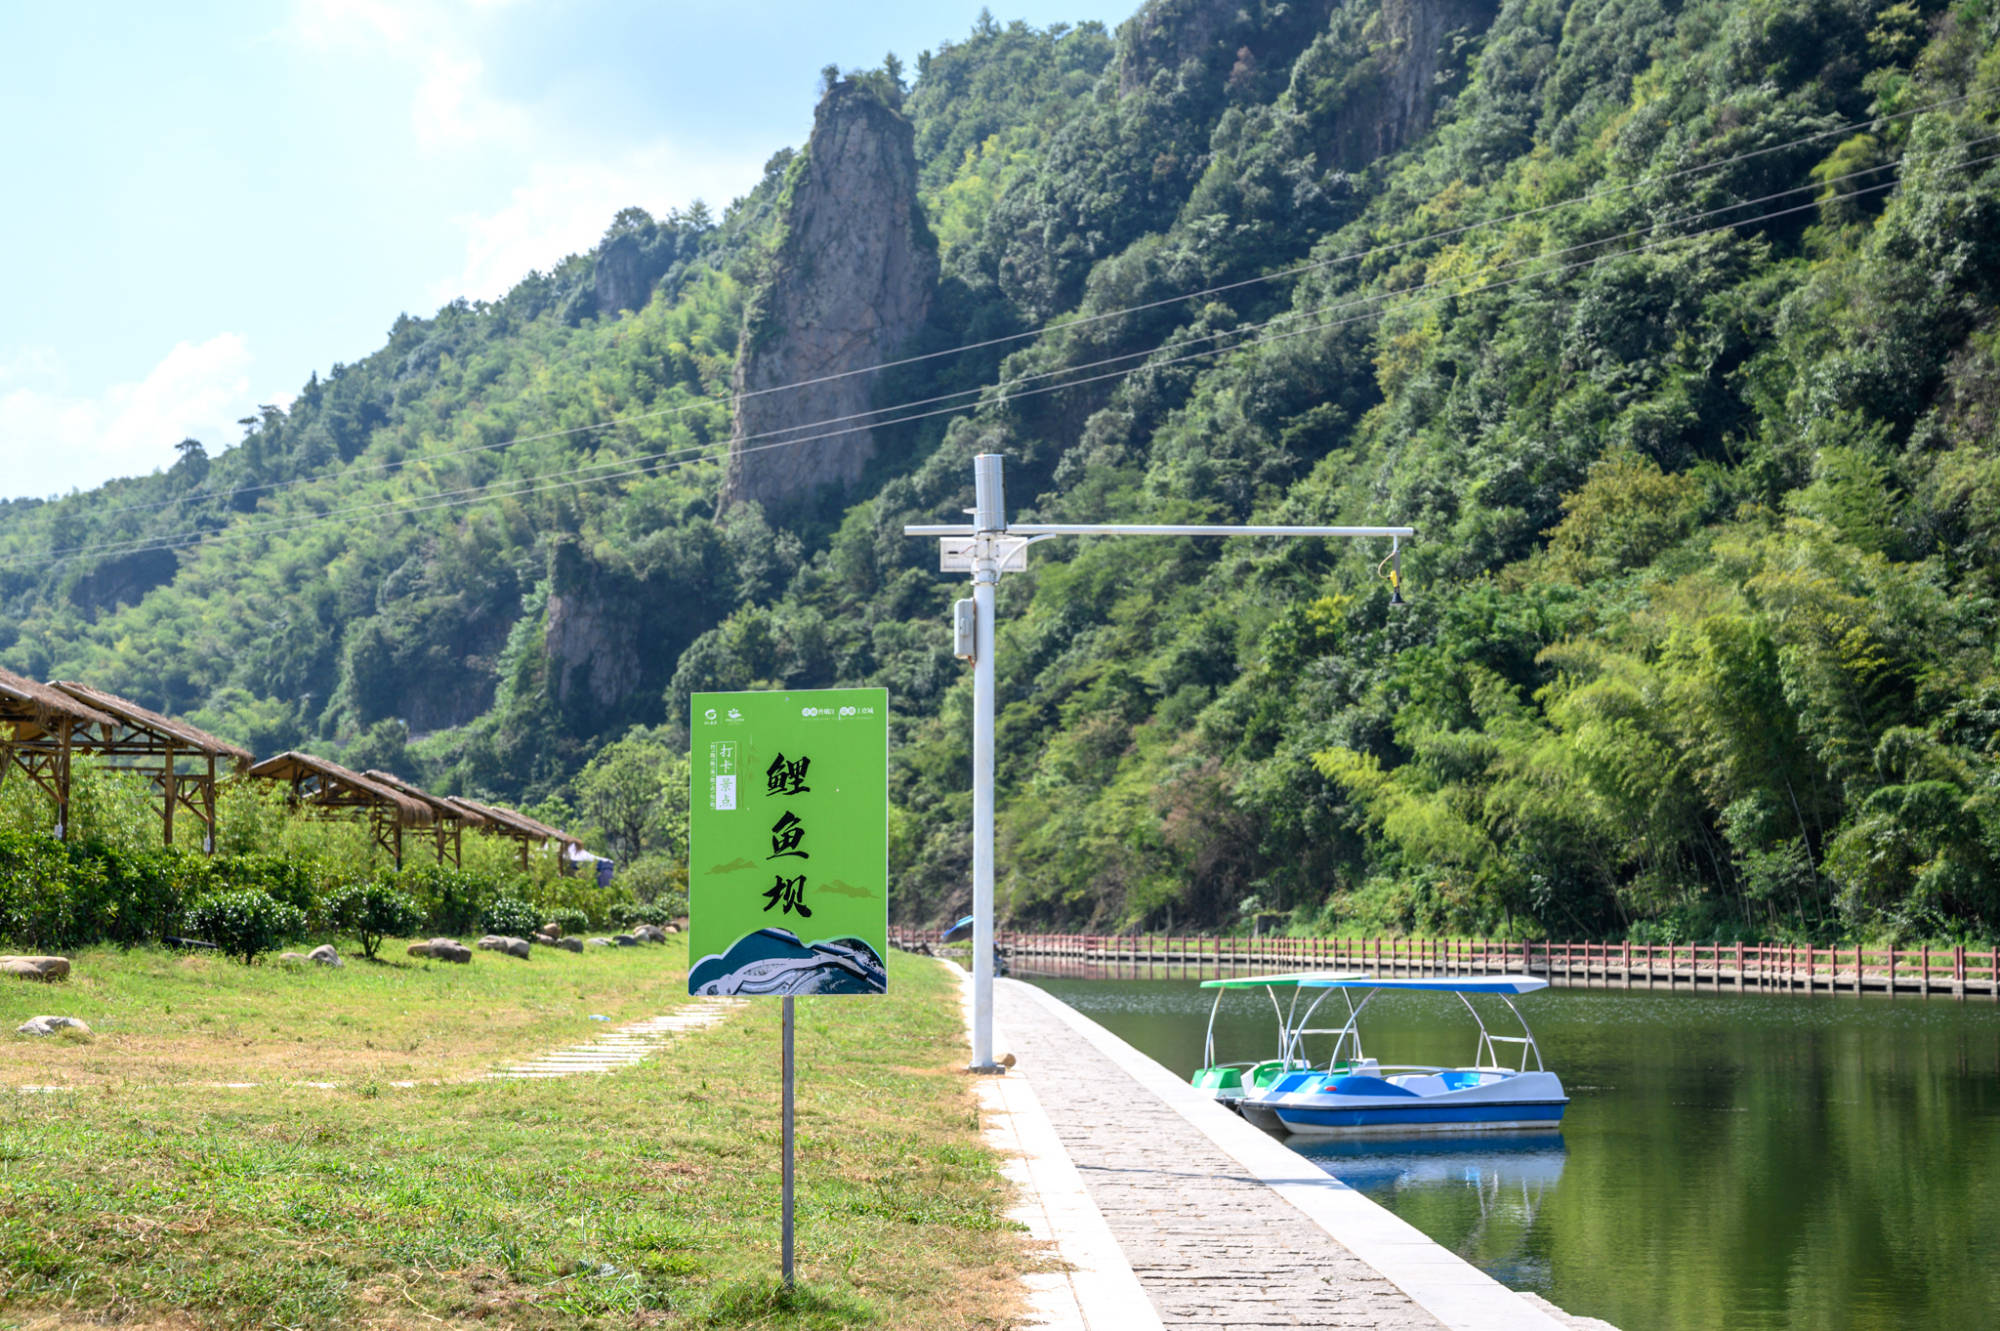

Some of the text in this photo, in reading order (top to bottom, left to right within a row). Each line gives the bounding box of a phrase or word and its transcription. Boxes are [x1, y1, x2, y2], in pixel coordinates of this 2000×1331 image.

[719, 743, 734, 808] 打卡景点
[762, 752, 812, 918] 鲤鱼坝
